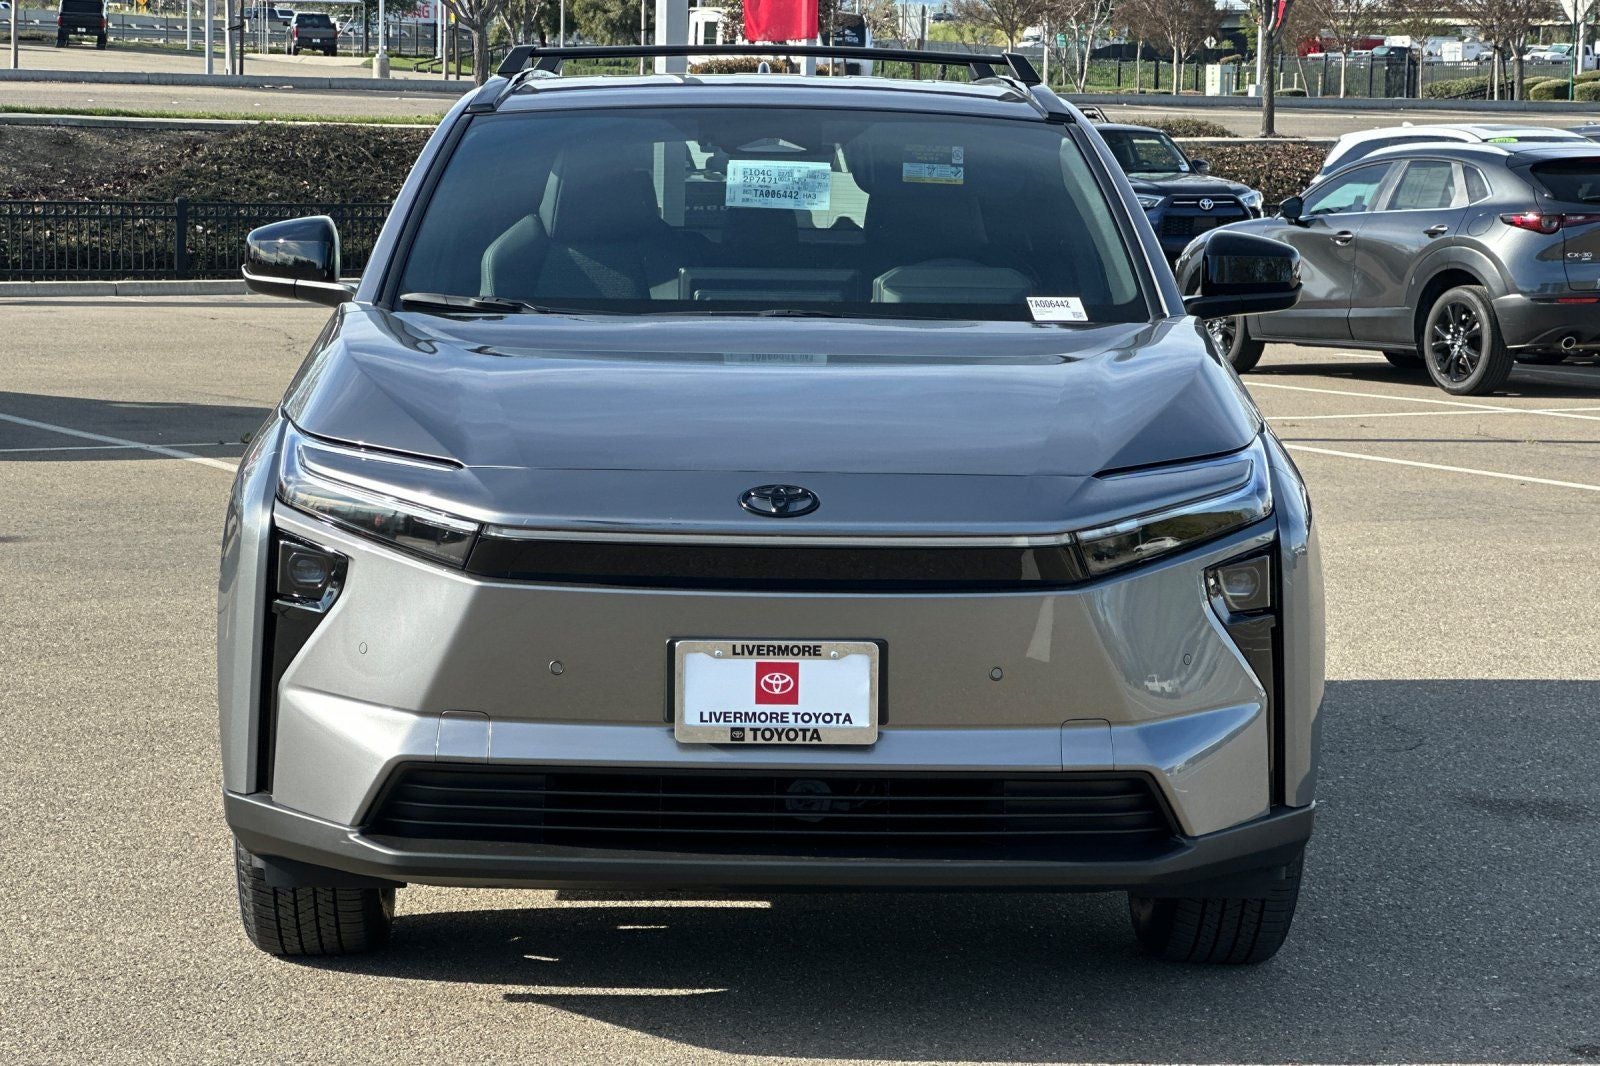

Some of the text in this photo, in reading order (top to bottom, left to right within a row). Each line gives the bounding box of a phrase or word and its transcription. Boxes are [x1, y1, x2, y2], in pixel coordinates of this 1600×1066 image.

[753, 188, 799, 200] TA006442
[1028, 299, 1070, 308] TA006442
[732, 644, 822, 657] LIVERMORE
[699, 711, 853, 725] LIVERMORE TOYOTA
[749, 728, 822, 742] TOYOTA
